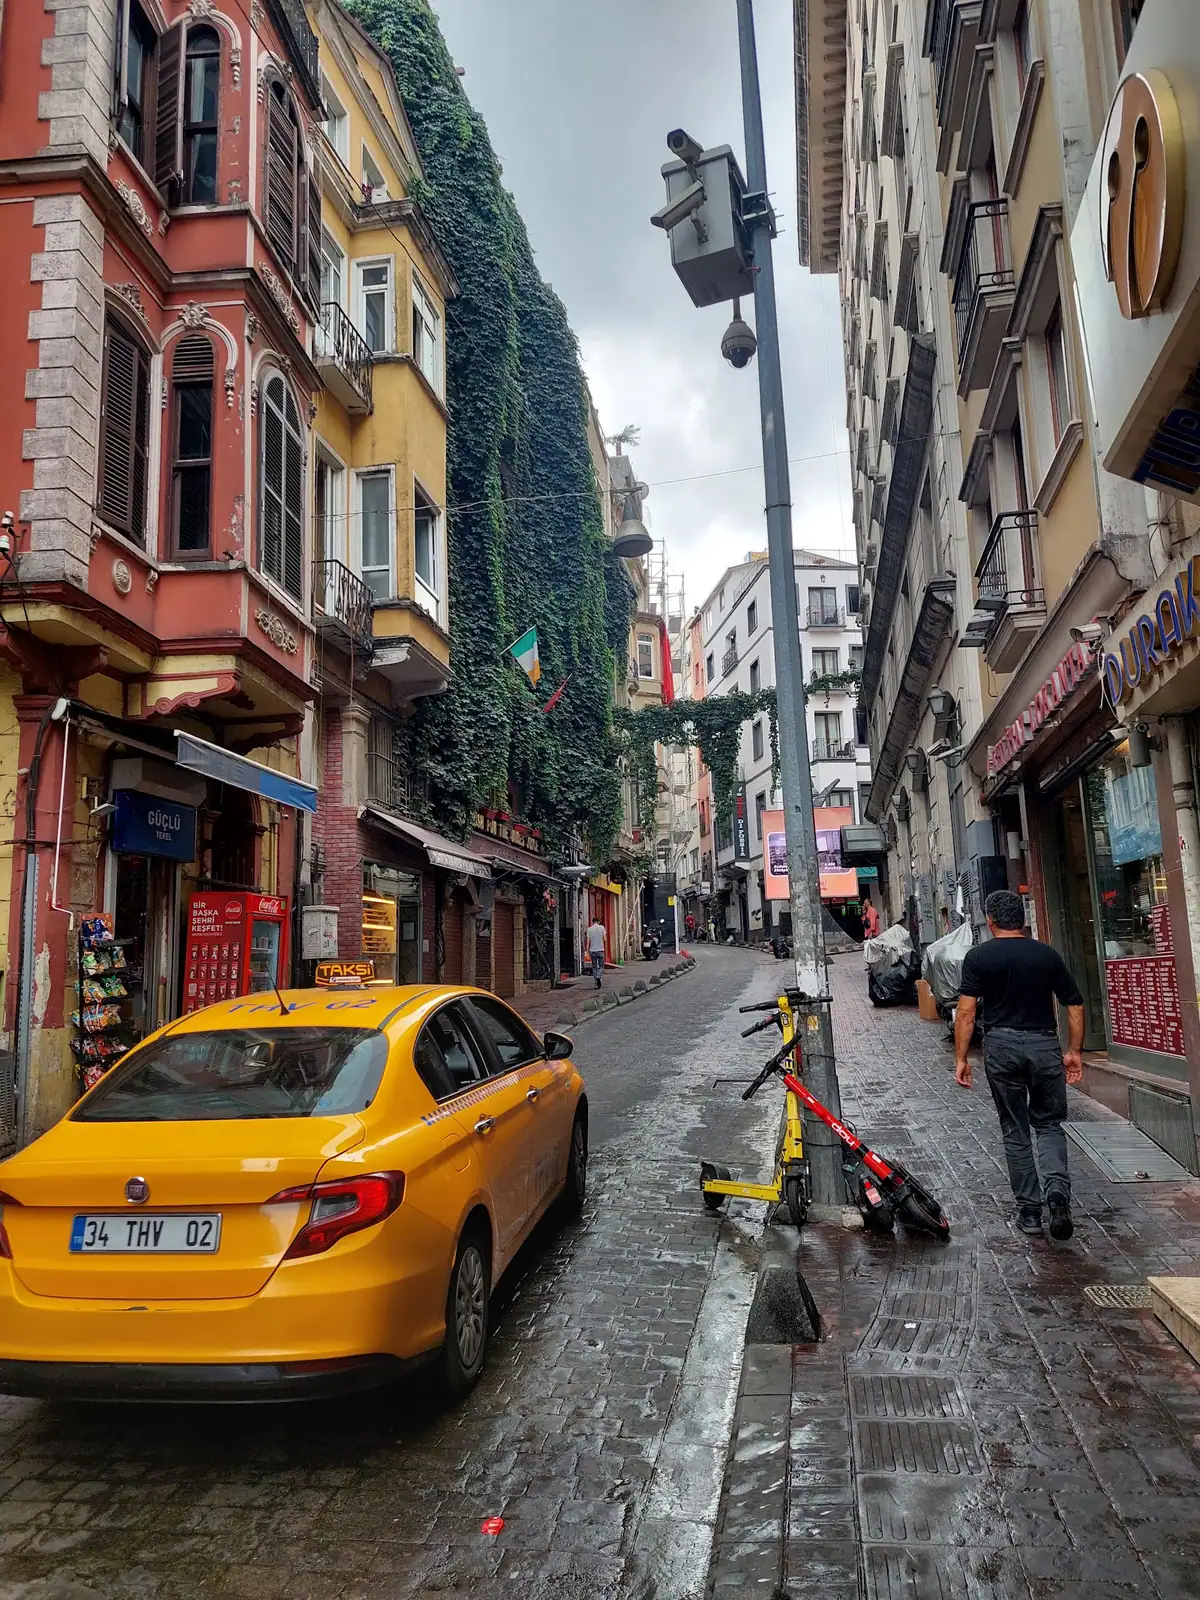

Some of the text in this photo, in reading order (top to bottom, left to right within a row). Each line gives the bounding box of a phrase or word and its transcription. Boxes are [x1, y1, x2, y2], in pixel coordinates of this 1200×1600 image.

[148, 809, 181, 832] GÜÇLÜ
[155, 830, 173, 842] TEKEL
[193, 901, 206, 909] BİR
[258, 898, 280, 914] Coca-Cola
[192, 909, 219, 917] BAŞKA
[192, 916, 215, 925] ŞEHRİ
[191, 924, 223, 933] KEŞFET!
[228, 999, 376, 1014] THV 02
[84, 1221, 109, 1247] 34
[126, 1220, 164, 1247] THV
[186, 1220, 213, 1247] 02
